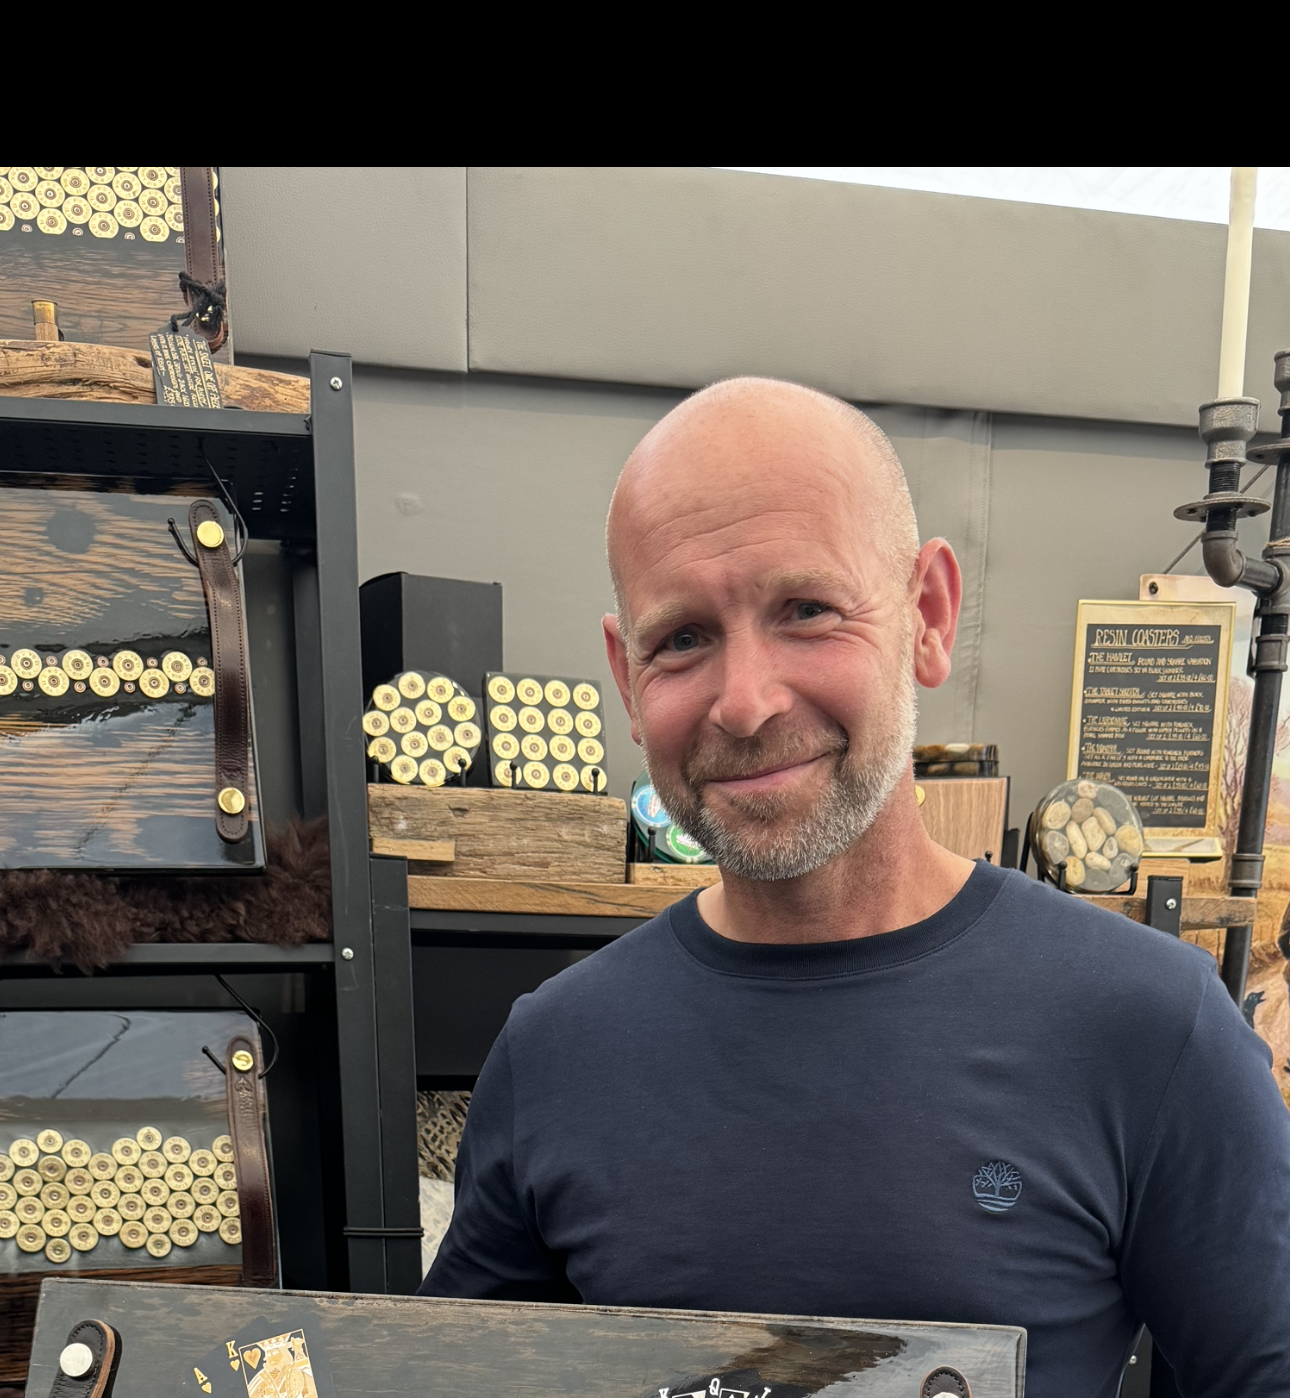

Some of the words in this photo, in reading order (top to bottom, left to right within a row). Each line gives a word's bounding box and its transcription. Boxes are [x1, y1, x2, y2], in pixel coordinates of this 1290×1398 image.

[1094, 628, 1127, 646] RESIN
[1132, 629, 1180, 646] COASTERS
[1089, 652, 1105, 663] THE
[225, 1340, 238, 1359] K
[194, 1367, 208, 1384] A
[709, 1377, 720, 1396] Q
